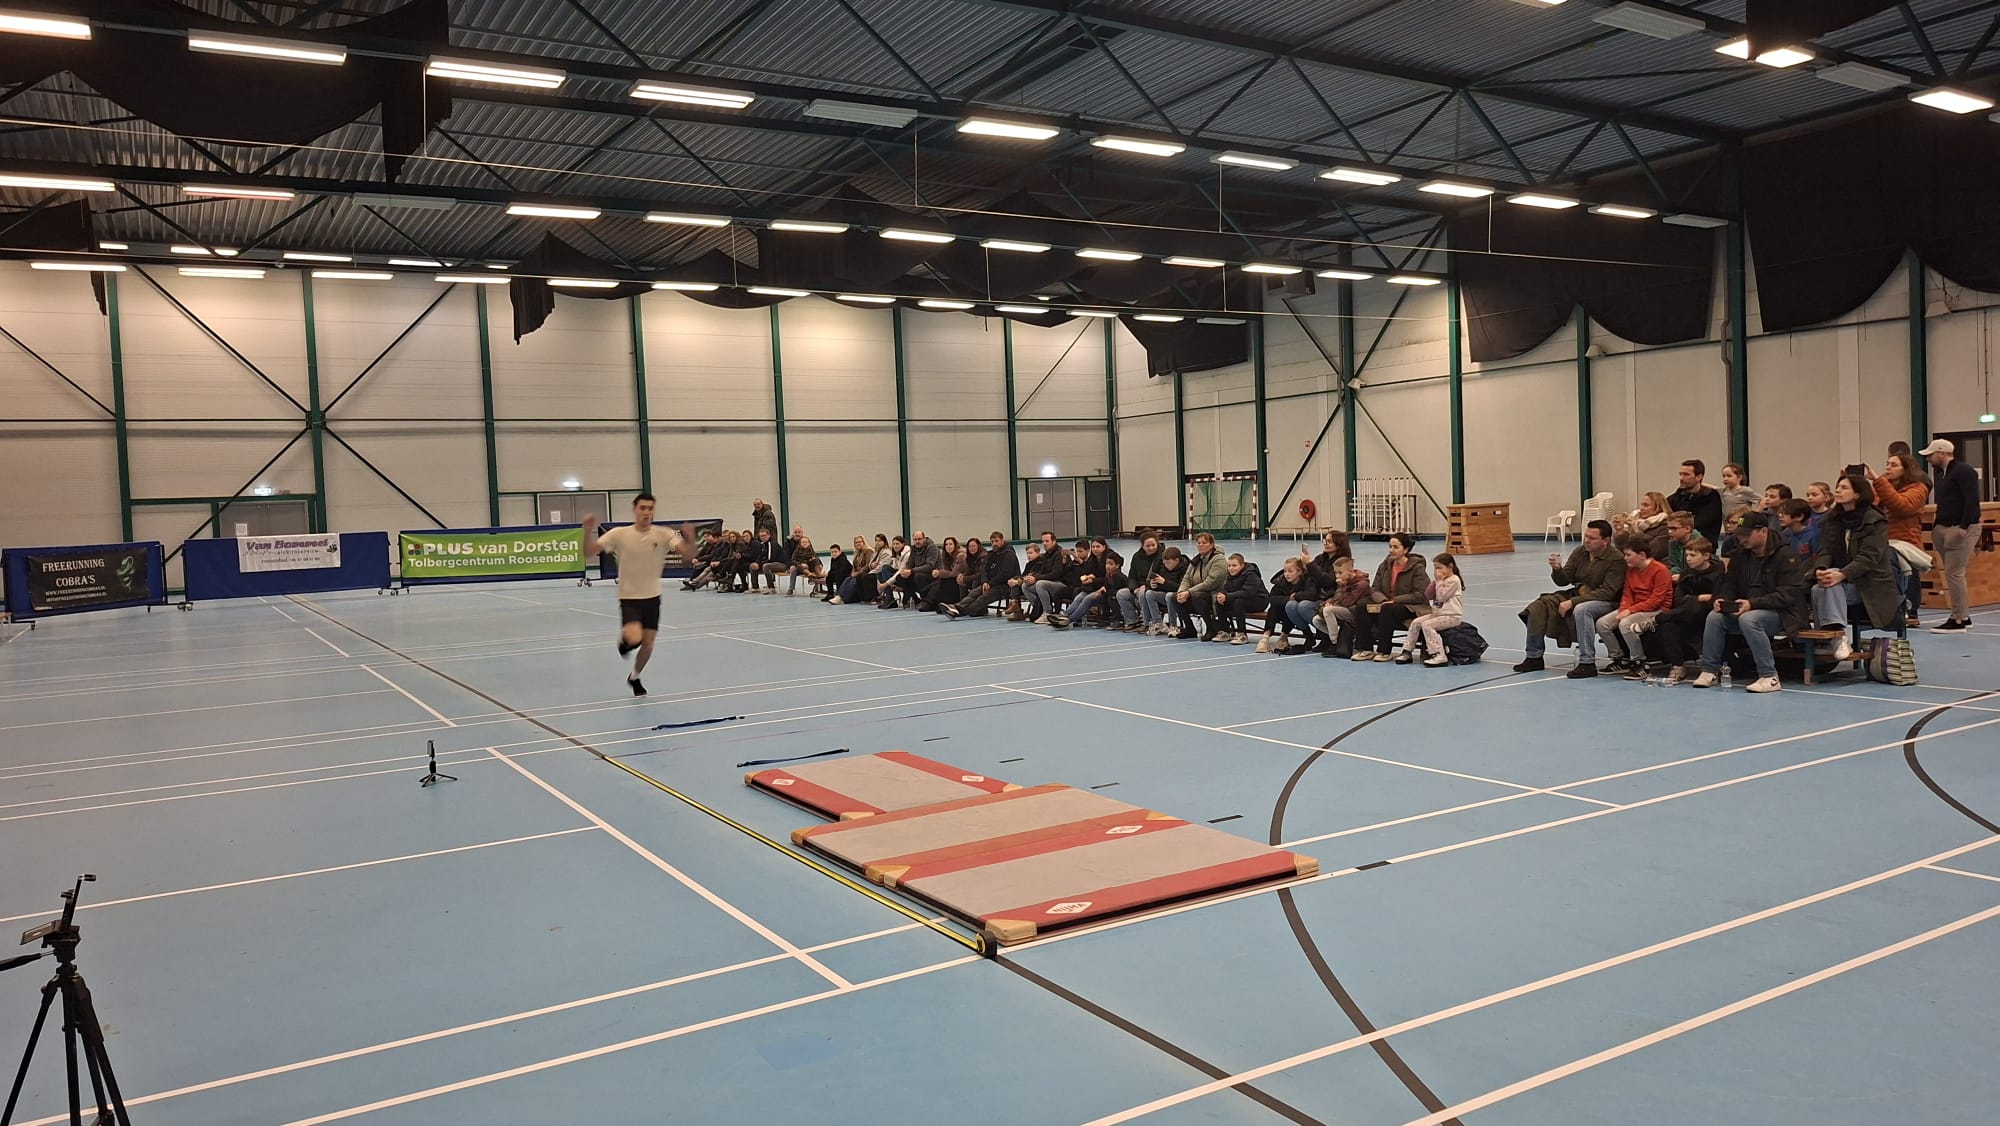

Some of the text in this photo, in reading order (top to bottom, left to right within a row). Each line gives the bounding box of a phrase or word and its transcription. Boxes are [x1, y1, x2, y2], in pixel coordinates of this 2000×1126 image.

[246, 538, 329, 551] Van Bommel
[423, 539, 579, 556] PLUS van Dorsten
[42, 558, 105, 573] FREERUNNING
[408, 552, 578, 569] Tolbergcentrum Roosendaal
[55, 574, 96, 587] COBRA'S
